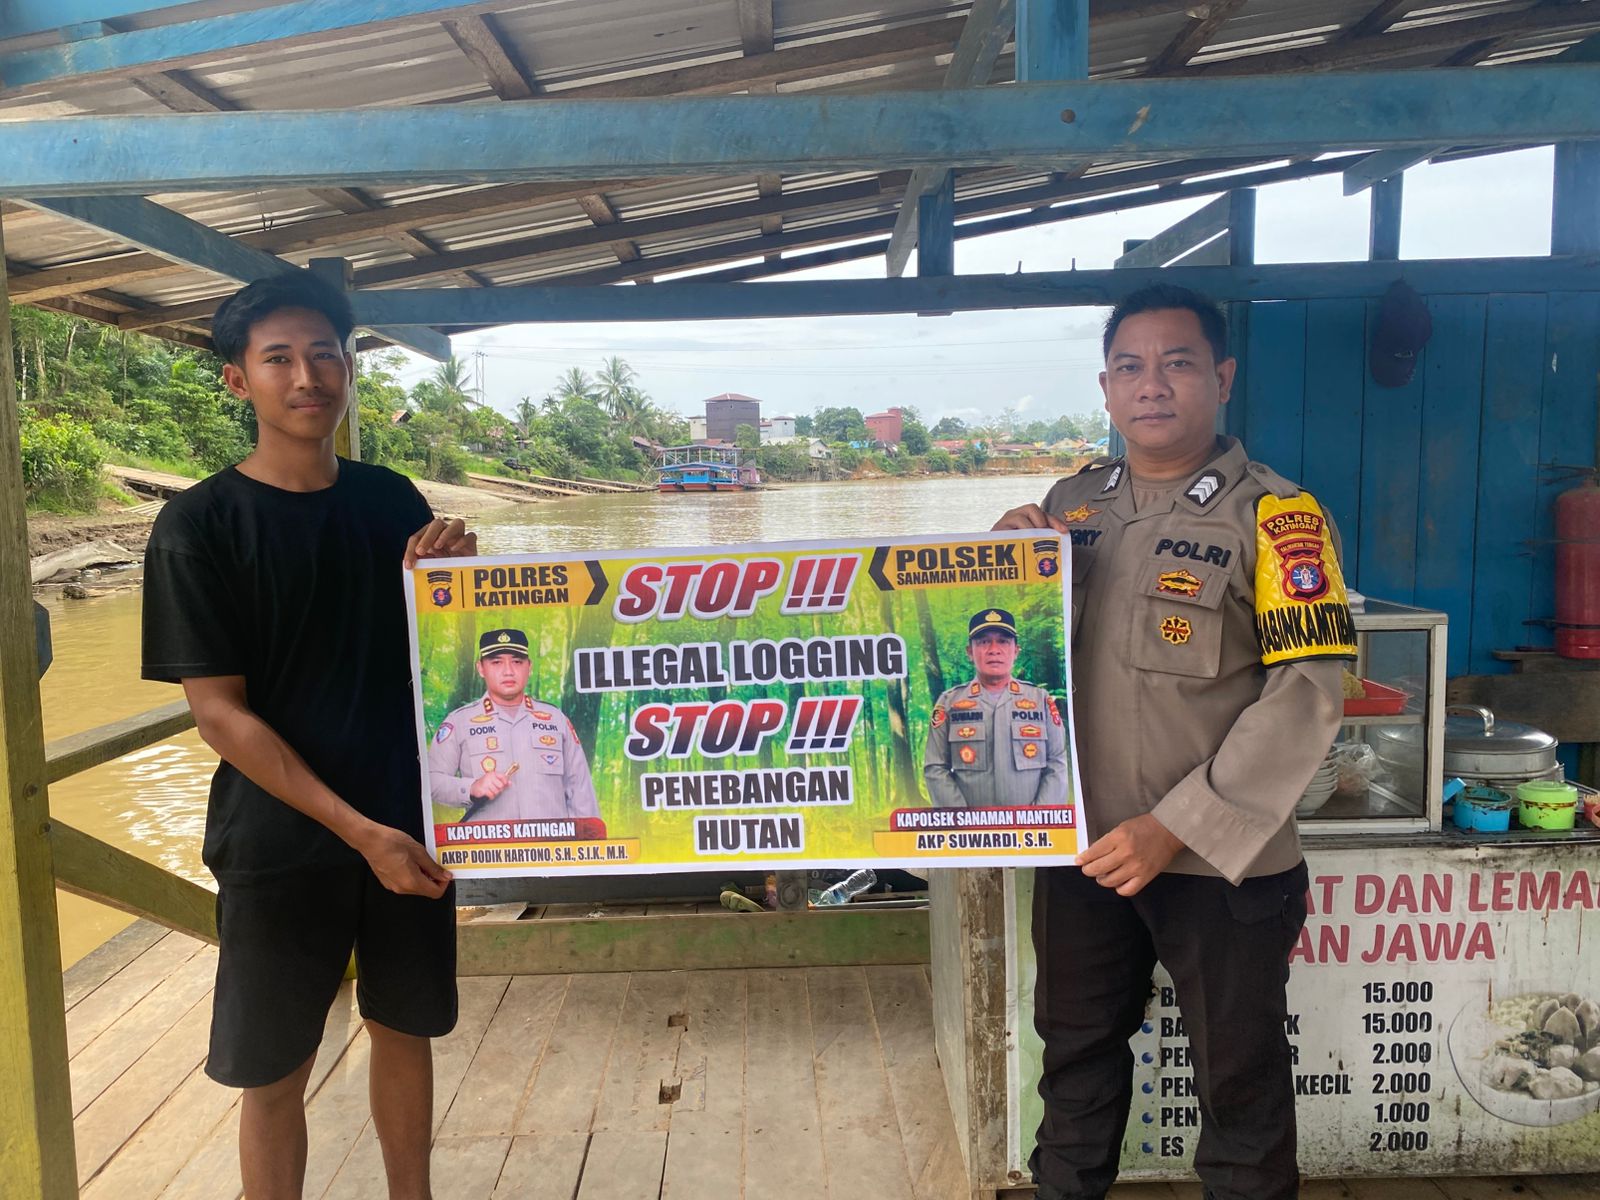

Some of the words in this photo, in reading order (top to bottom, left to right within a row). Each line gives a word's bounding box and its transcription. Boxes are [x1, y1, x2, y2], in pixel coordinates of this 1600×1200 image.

[1267, 514, 1320, 529] POLRES
[1273, 522, 1317, 535] KATINGAN
[896, 544, 1018, 572] POLSEK
[1154, 538, 1232, 568] POLRI
[474, 565, 568, 589] POLRES
[617, 560, 780, 617] STOP
[786, 556, 859, 609] !!!
[897, 570, 956, 586] SANAMAN
[959, 567, 1019, 583] MANTIKEI
[475, 588, 569, 607] KATINGAN
[578, 645, 724, 690] ILLEGAL
[733, 637, 904, 682] LOGGING
[532, 722, 558, 731] POLRI
[627, 702, 784, 757] STOP
[789, 698, 860, 750] !!!
[1012, 711, 1043, 721] POLRI
[469, 726, 496, 736] DODIK
[644, 770, 850, 807] PENEBANGAN
[896, 811, 954, 828] KAPOLSEK
[957, 811, 1013, 826] SANAMAN
[1016, 809, 1072, 825] MANTIKEI
[447, 824, 511, 841] KAPOLRES
[513, 822, 576, 839] KATINGAN
[697, 818, 801, 851] HUTAN
[917, 834, 945, 849] AKP
[949, 833, 1021, 848] SUWARDI,
[1025, 832, 1052, 847] S.H.
[442, 850, 468, 865] AKBP
[471, 849, 502, 864] DODIK
[504, 848, 553, 863] HARTONO,
[606, 845, 628, 859] M.H.
[1354, 873, 1453, 915] DAN
[1468, 870, 1600, 912] LEMA
[1361, 921, 1497, 963] JAWA
[1362, 981, 1433, 1003] 15.000
[1161, 1017, 1189, 1038] BA
[1362, 1012, 1432, 1034] 15.000
[1372, 1042, 1431, 1064] 2.000
[1296, 1074, 1351, 1095] KECIL
[1372, 1072, 1431, 1094] 2.000
[1161, 1107, 1200, 1127] PEN
[1374, 1102, 1430, 1123] 1.000
[1161, 1136, 1184, 1157] ES
[1369, 1131, 1428, 1151] 2.000
